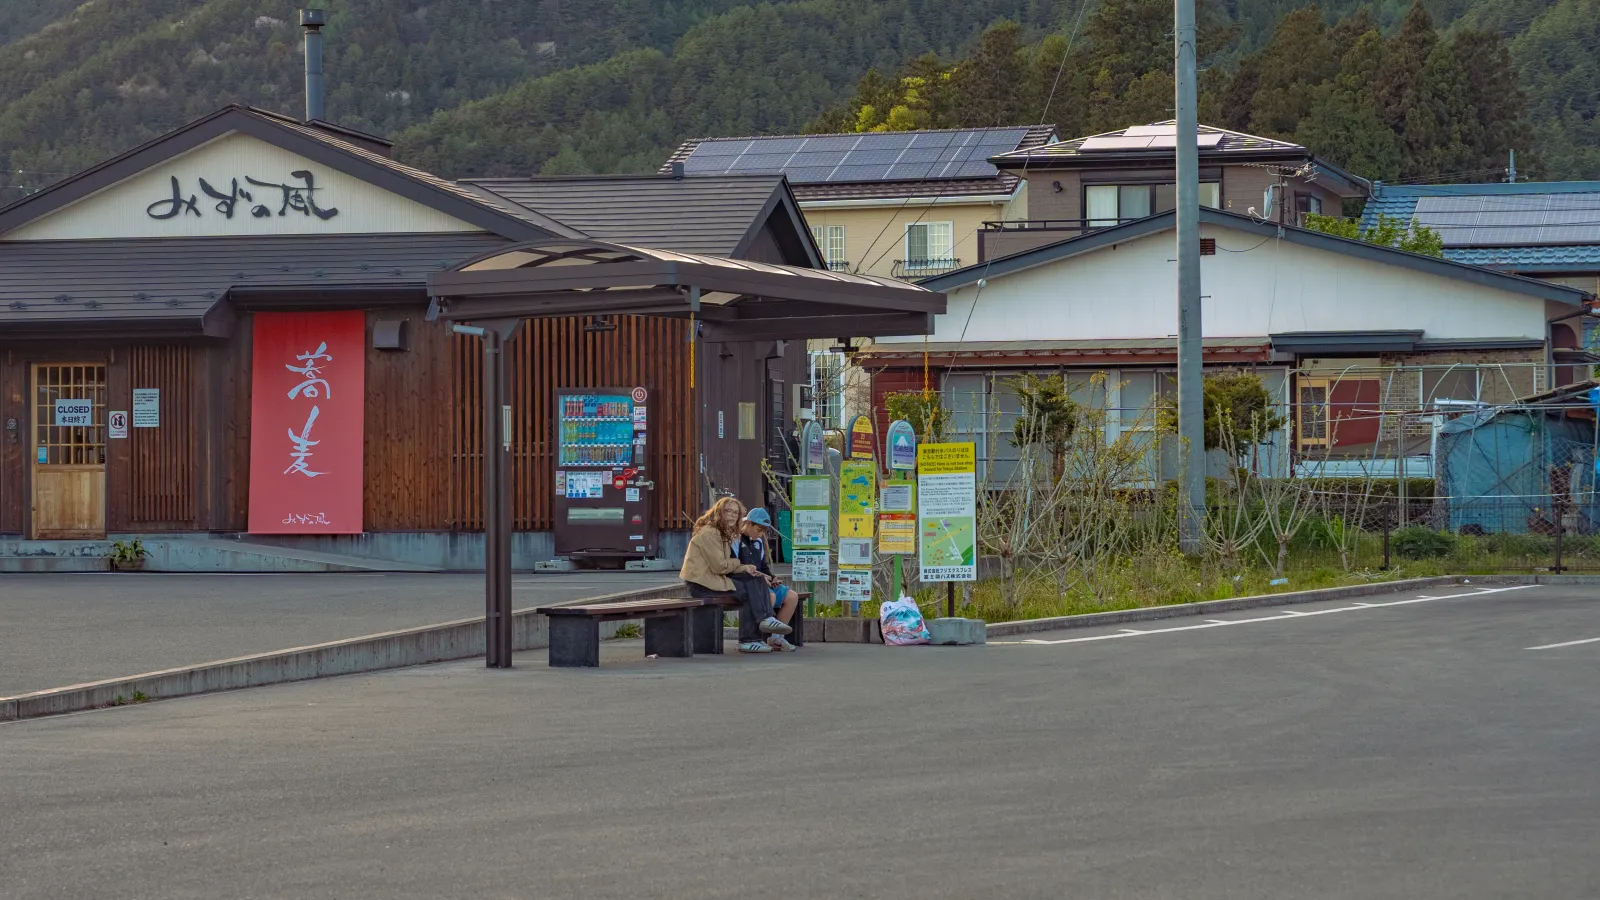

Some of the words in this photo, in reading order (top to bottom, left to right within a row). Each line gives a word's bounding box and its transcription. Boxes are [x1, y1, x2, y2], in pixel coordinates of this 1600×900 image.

[147, 170, 339, 220] みずの風
[57, 405, 90, 414] CLOSED
[284, 341, 332, 477] 蕎麦
[61, 415, 87, 424] 本日終了
[282, 512, 331, 525] みずの風
